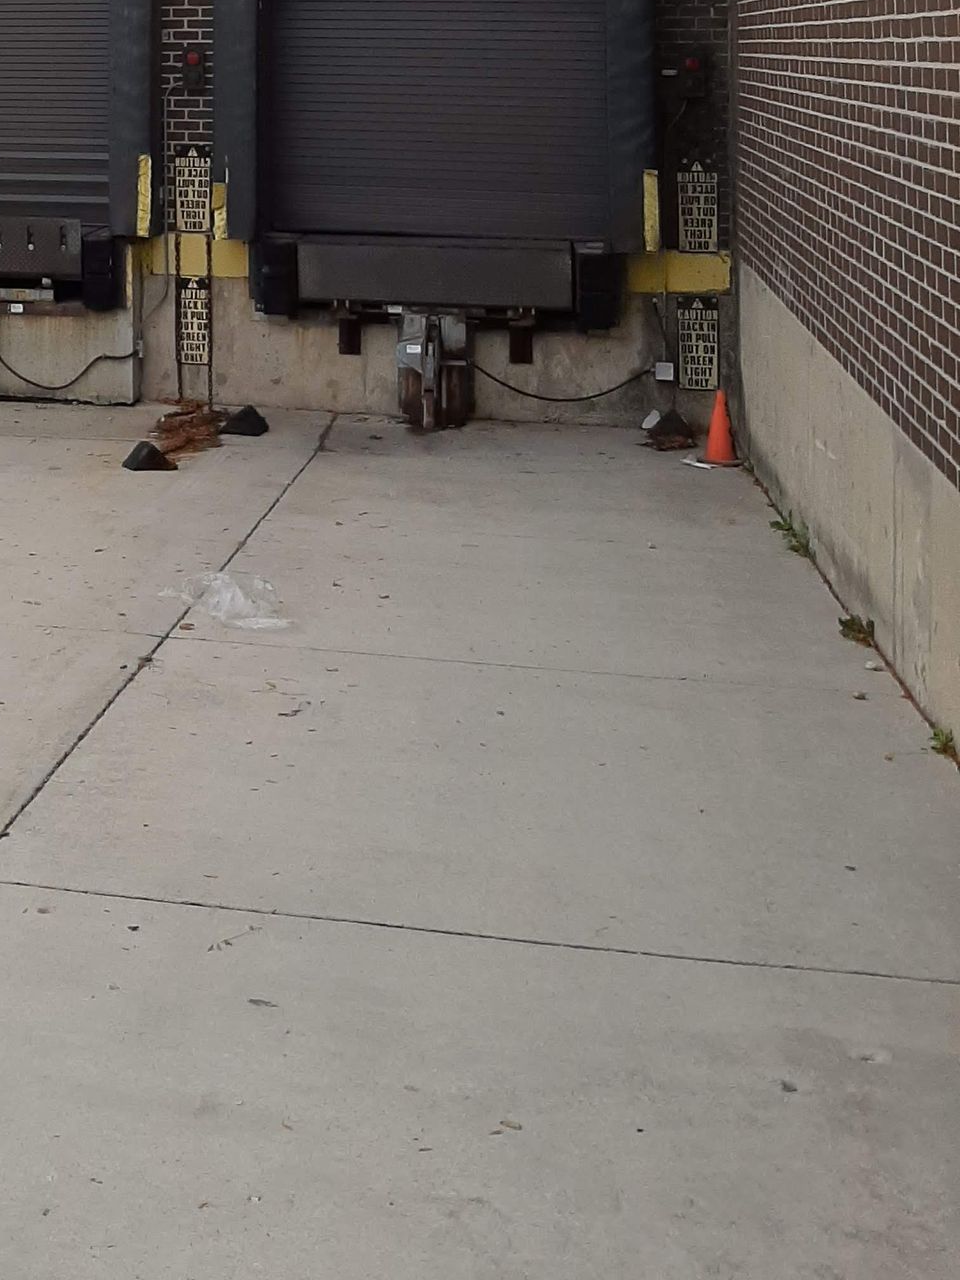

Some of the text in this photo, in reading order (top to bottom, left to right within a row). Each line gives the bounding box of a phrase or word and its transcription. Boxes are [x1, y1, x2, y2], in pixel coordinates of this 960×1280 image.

[180, 289, 208, 299] AUTIO
[182, 300, 199, 310] ACK
[677, 309, 718, 320] CAUTION
[183, 321, 194, 331] UT
[679, 321, 716, 332] BACK IN
[180, 332, 208, 342] GREEN
[679, 333, 717, 344] OR PULL
[180, 342, 206, 353] LIGHT
[681, 344, 716, 355] OUT ON
[183, 353, 204, 362] ONLY
[683, 355, 714, 366] GREEN
[684, 367, 713, 378] LIGHT
[687, 377, 710, 387] ONLY
